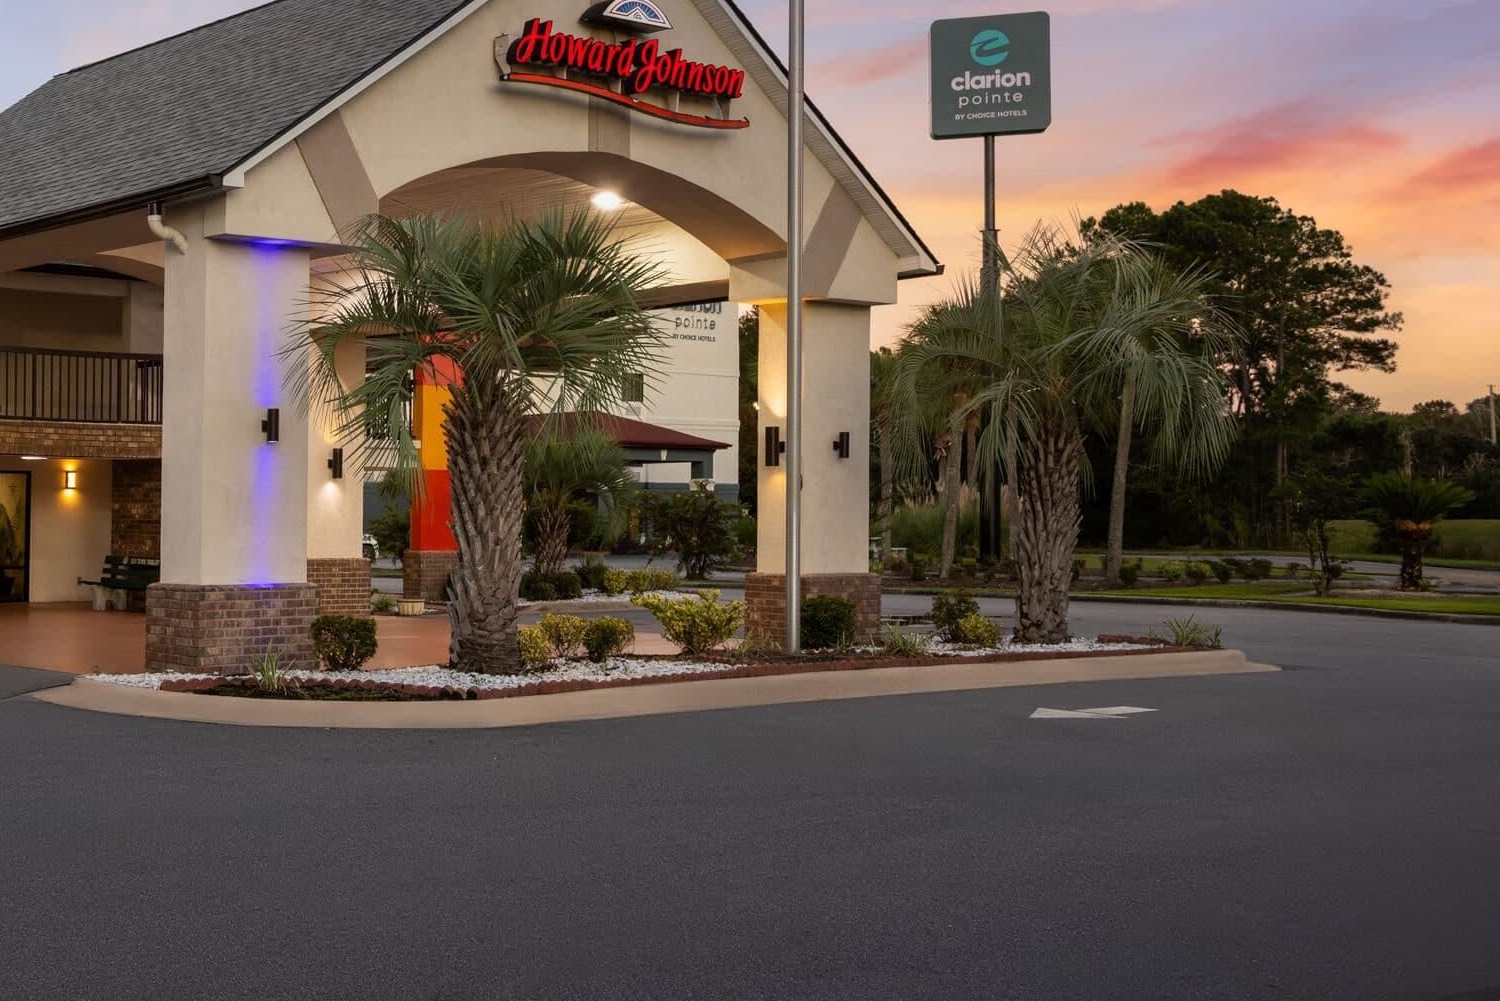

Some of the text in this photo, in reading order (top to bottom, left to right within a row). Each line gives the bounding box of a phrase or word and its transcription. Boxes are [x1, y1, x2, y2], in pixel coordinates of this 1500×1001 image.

[515, 18, 745, 98] Howard Johnson
[950, 69, 1031, 91] clarion
[958, 92, 1023, 109] pointe
[966, 111, 996, 119] CHOICE
[997, 109, 1028, 117] HOTELS
[675, 315, 716, 330] pointe
